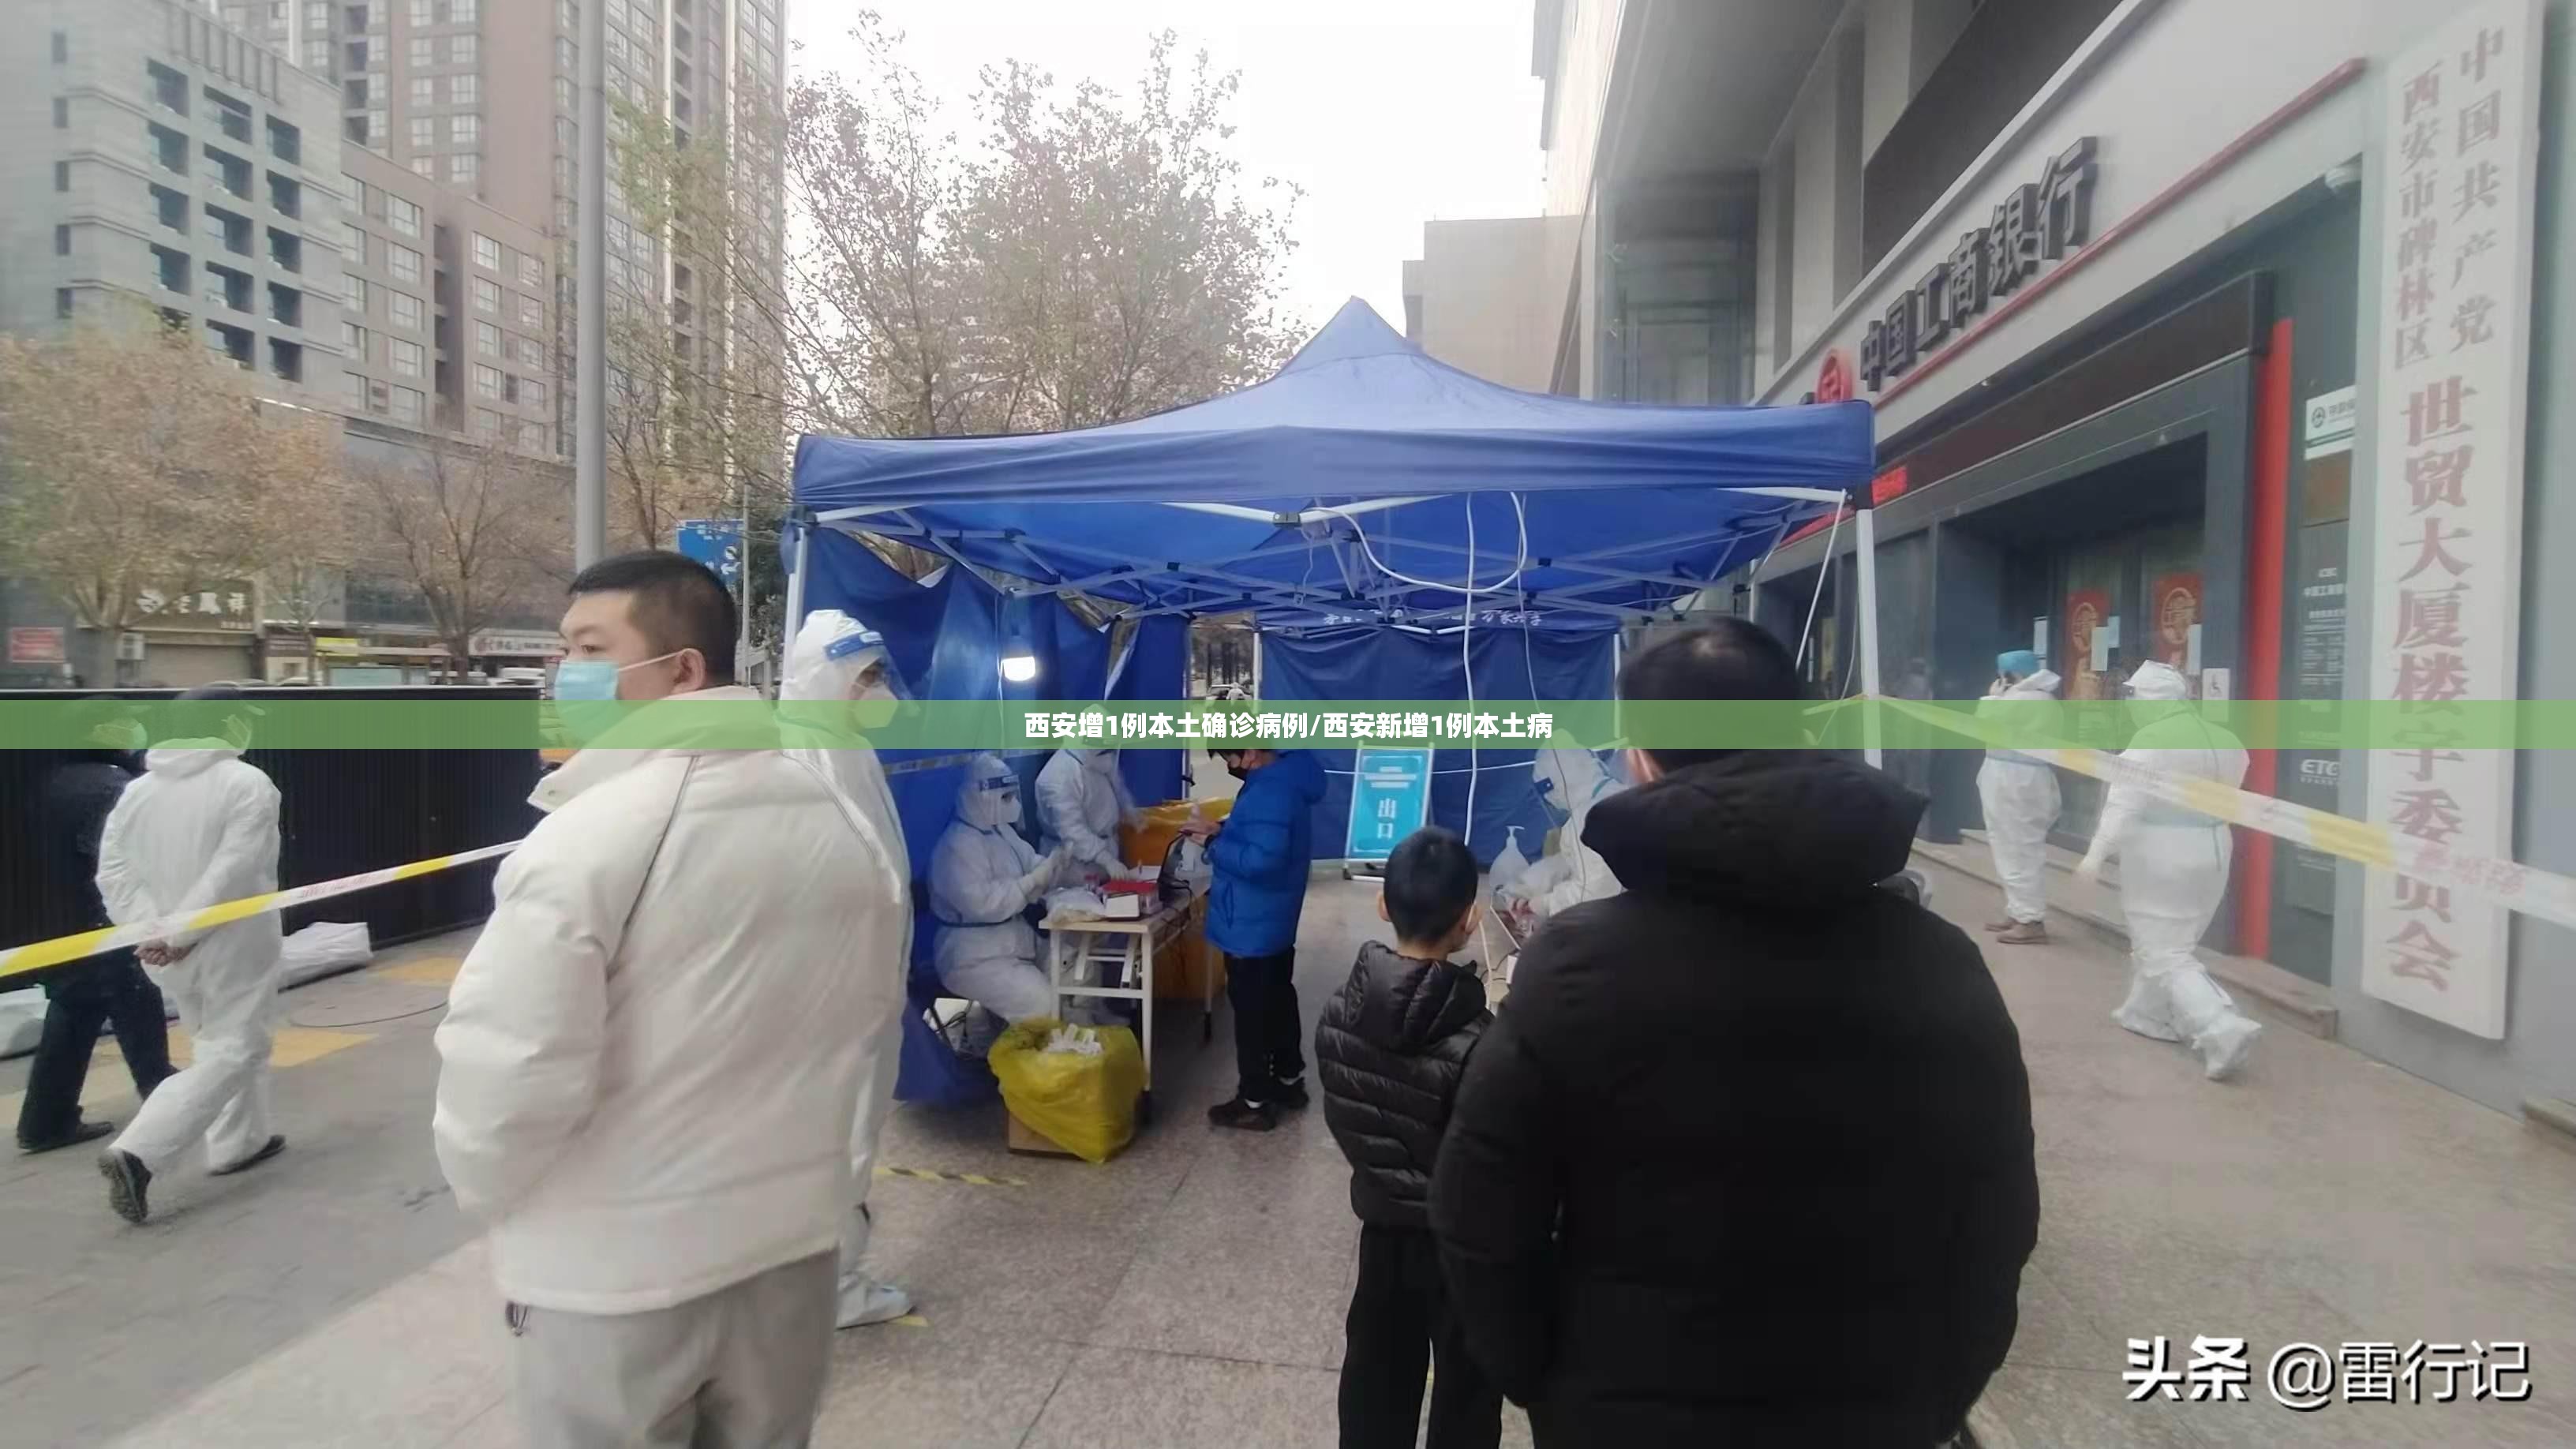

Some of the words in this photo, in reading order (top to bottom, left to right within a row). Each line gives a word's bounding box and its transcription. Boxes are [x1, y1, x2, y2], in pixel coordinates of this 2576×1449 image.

[1860, 136, 2098, 392] 中国工商银行
[2394, 60, 2444, 370] 西安市碑林区
[2450, 27, 2503, 354] 中国共产党
[1376, 798, 1397, 840] 出口
